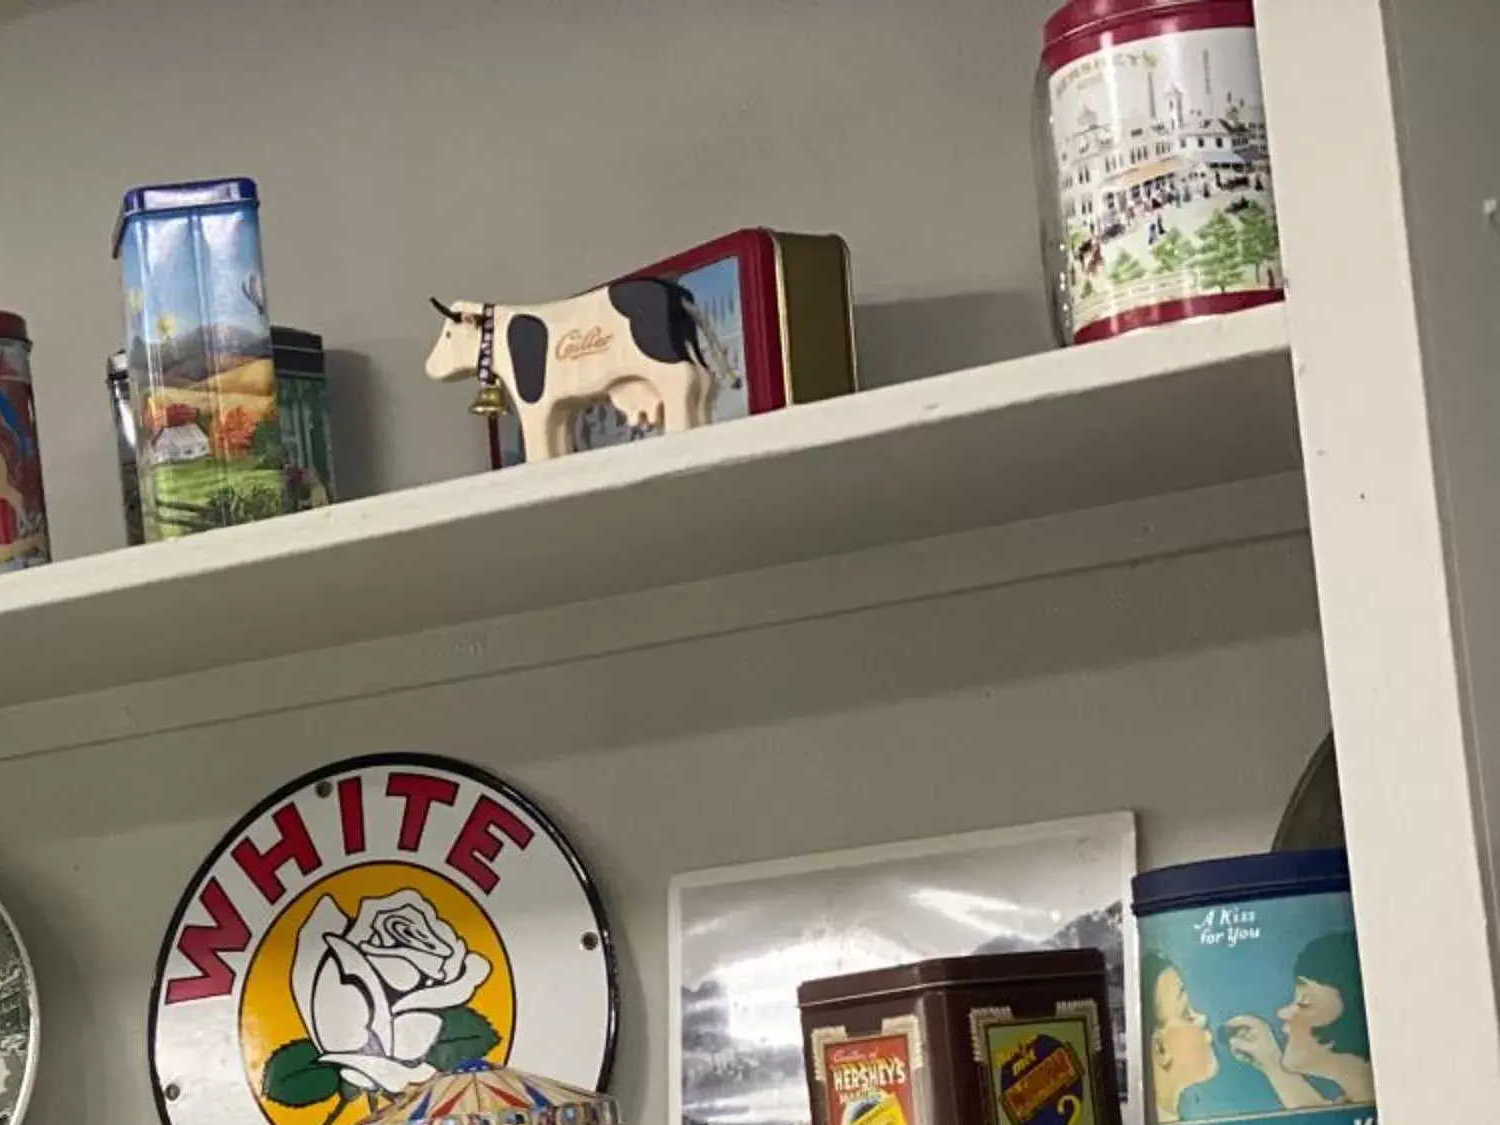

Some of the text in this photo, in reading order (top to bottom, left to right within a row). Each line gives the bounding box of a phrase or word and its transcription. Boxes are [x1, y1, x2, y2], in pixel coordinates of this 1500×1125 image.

[165, 772, 535, 1005] WHITE
[1192, 905, 1256, 930] A Kiss
[1200, 927, 1261, 949] for You
[831, 1056, 906, 1092] HERSHEY'S
